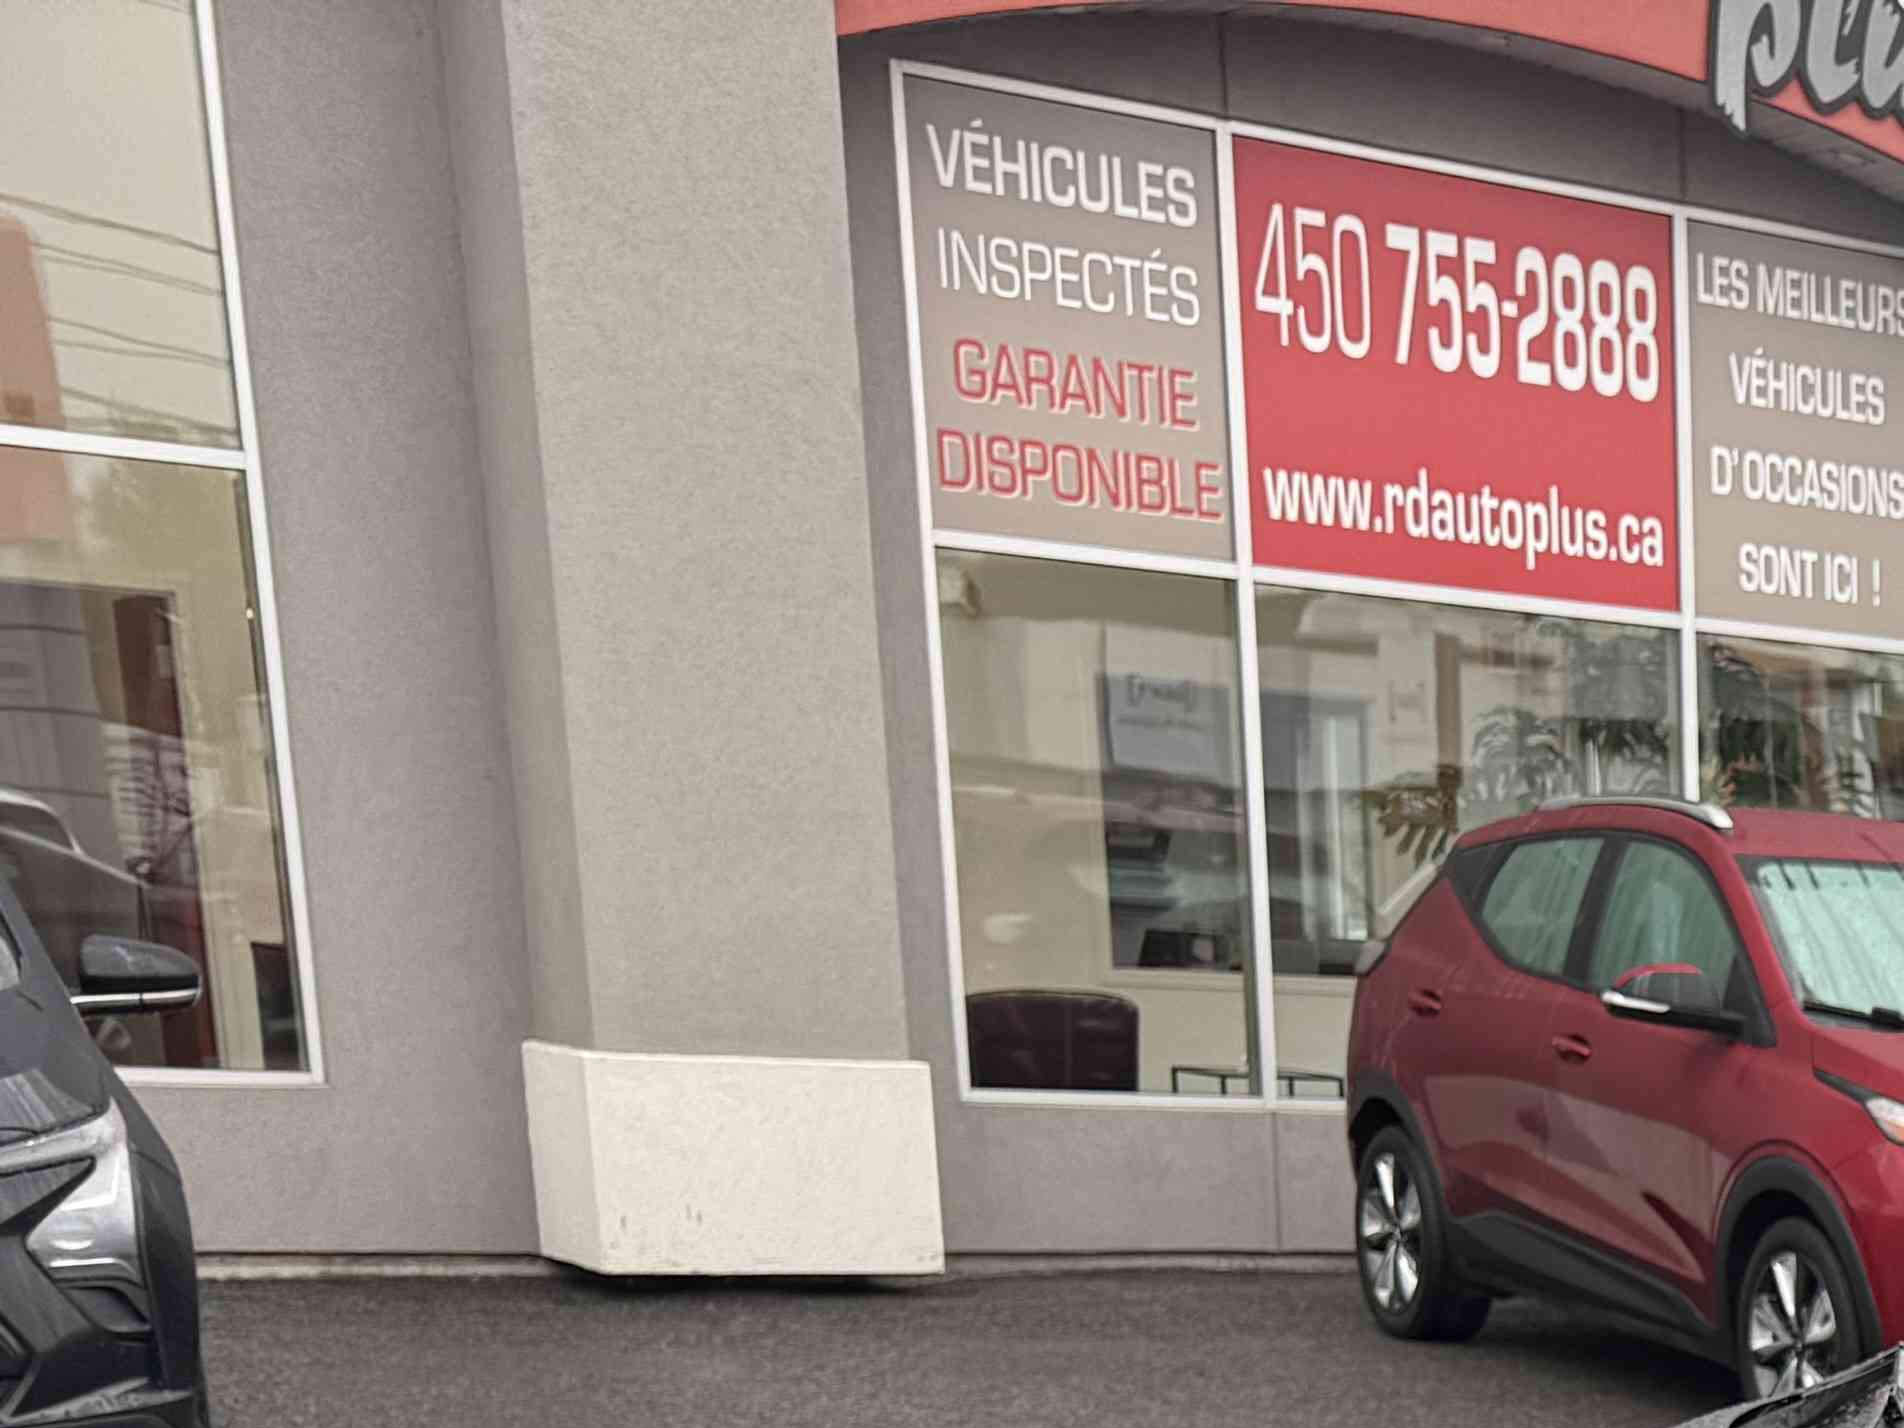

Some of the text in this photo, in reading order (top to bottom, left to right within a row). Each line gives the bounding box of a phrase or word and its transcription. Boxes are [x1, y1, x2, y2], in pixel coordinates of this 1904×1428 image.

[926, 119, 1197, 227] VÉHICULES
[938, 227, 1201, 326] INSPECTÉS
[1255, 202, 1660, 402] 450 755-2888
[1696, 252, 1750, 310] LES
[953, 338, 1200, 432] GARANTIE
[1729, 346, 1885, 425] VÉHICULES
[936, 428, 1224, 523] DISPONIBLE
[1263, 467, 1664, 570] www.rdautoplus.ca
[1738, 542, 1819, 598] SONT
[1824, 551, 1858, 604] ICI
